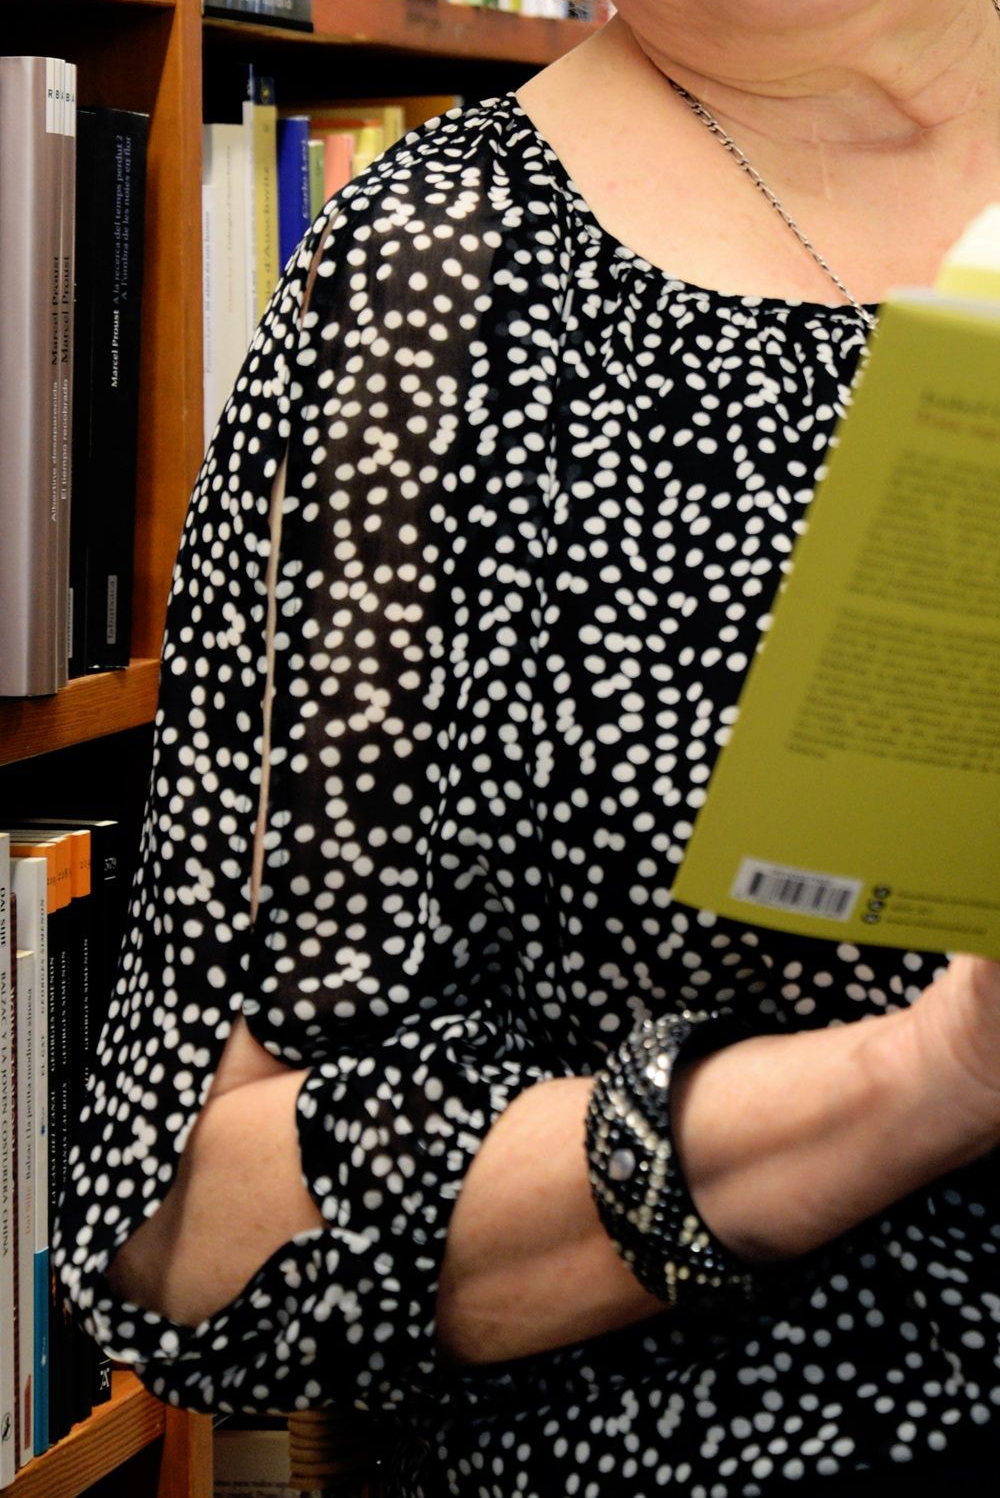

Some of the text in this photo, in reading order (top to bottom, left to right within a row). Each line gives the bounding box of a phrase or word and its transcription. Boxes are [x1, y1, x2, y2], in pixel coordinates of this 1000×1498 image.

[115, 134, 123, 142] 2
[124, 136, 132, 157] flor
[114, 143, 124, 182] perdut
[124, 158, 131, 173] en
[115, 183, 124, 220] temps
[123, 174, 131, 206] noies
[122, 208, 130, 224] les
[122, 226, 129, 241] de
[262, 165, 273, 273] d'Auschwitz
[113, 242, 121, 281] recerca
[120, 242, 129, 286] l'ombra
[112, 283, 120, 293] la
[111, 309, 120, 347] Proust
[60, 255, 70, 500] El tiempo recobrado Marcel Proust
[110, 349, 119, 388] Marcel
[50, 255, 59, 522] Albertine desaparecida Marcel Proust
[107, 579, 117, 640] labutxaca
[0, 971, 8, 1023] BALZAC
[1, 1030, 8, 1039] Y
[1, 1046, 8, 1062] LA
[25, 1082, 34, 1119] petita
[25, 1120, 32, 1132] la
[1, 1120, 9, 1204] COSTURERA
[25, 1142, 33, 1181] Balzac
[50, 1190, 57, 1205] LA
[2, 1208, 10, 1258] CHINA
